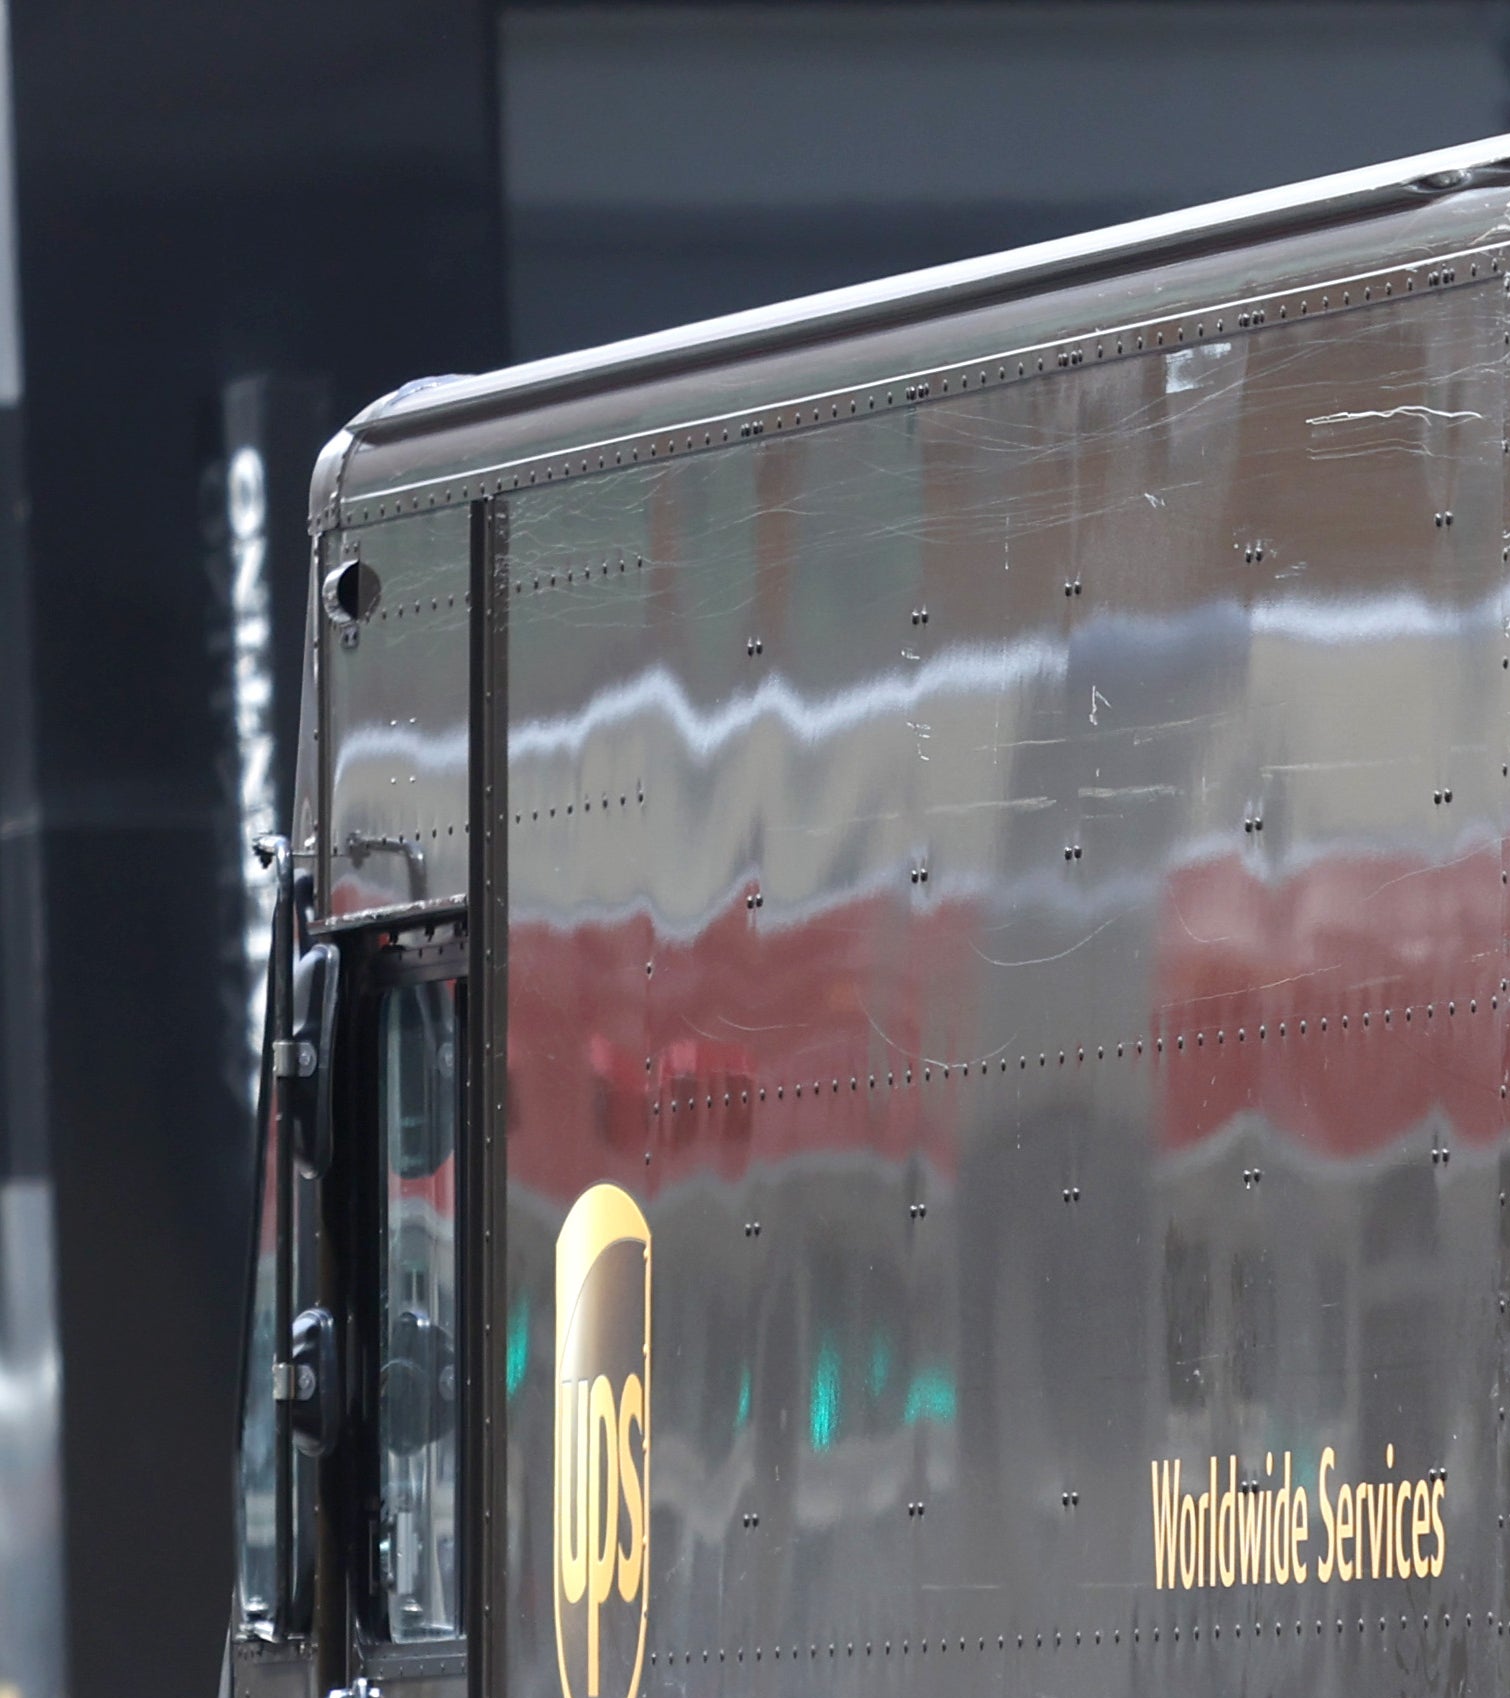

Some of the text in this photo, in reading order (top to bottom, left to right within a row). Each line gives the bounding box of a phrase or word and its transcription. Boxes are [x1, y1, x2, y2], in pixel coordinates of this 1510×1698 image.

[562, 1373, 643, 1697] ups
[1152, 1443, 1446, 1589] Worldwide Services
